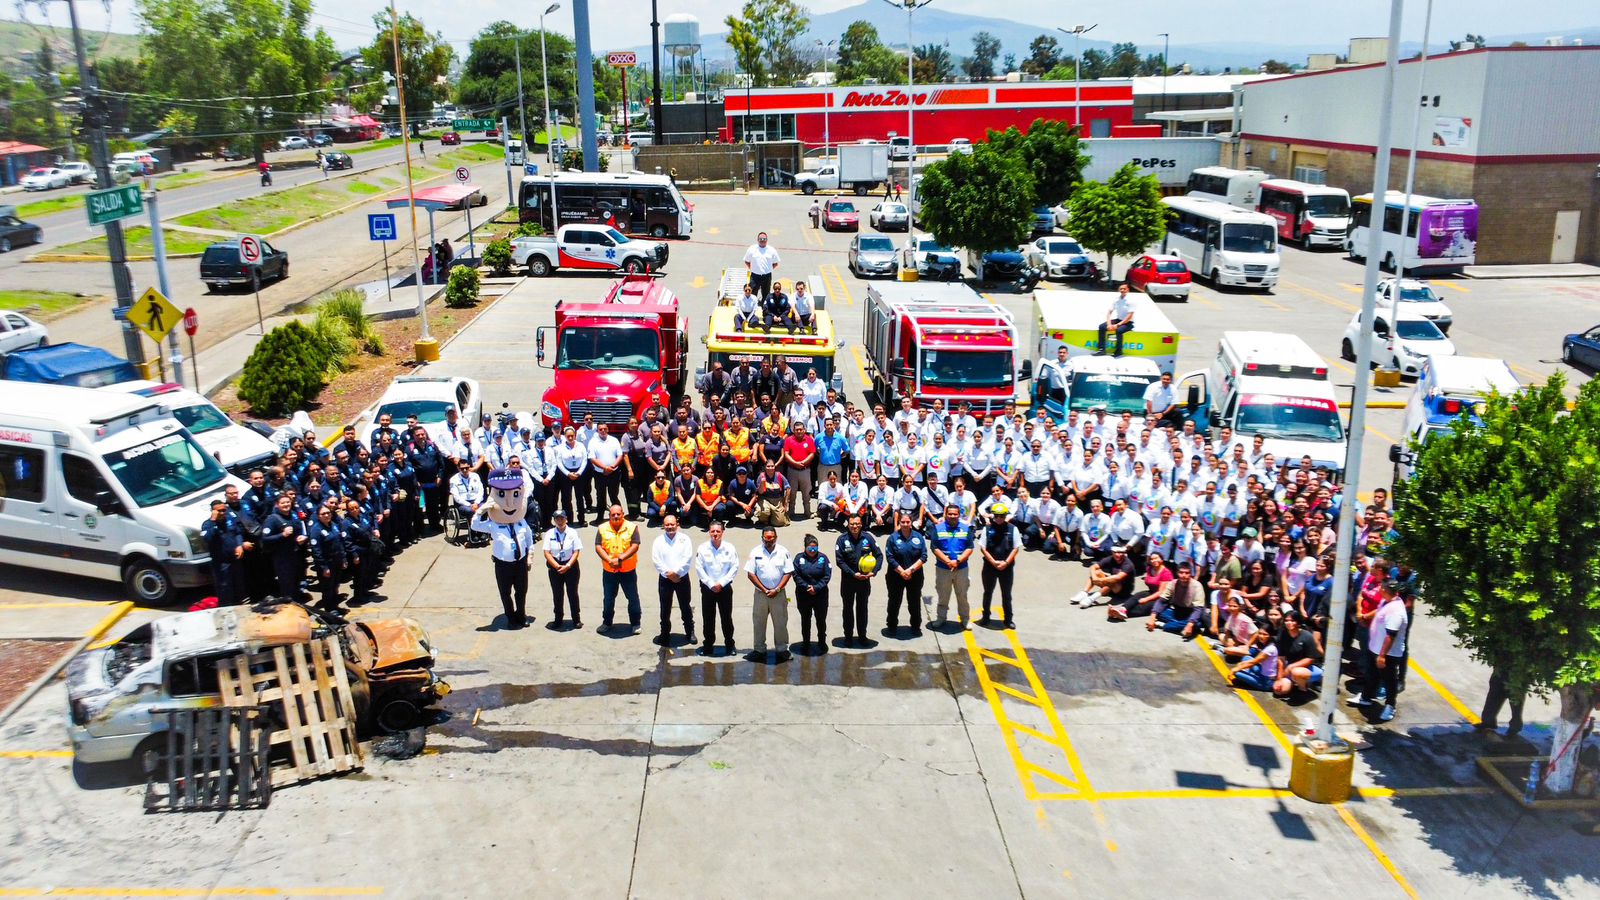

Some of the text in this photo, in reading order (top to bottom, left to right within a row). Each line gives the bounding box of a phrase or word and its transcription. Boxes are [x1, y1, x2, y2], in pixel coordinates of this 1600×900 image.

[609, 54, 635, 64] OXXO
[842, 90, 928, 107] AutoZone
[454, 120, 480, 128] ENTRADA
[1132, 157, 1177, 168] PePes
[91, 191, 125, 214] SALIDA
